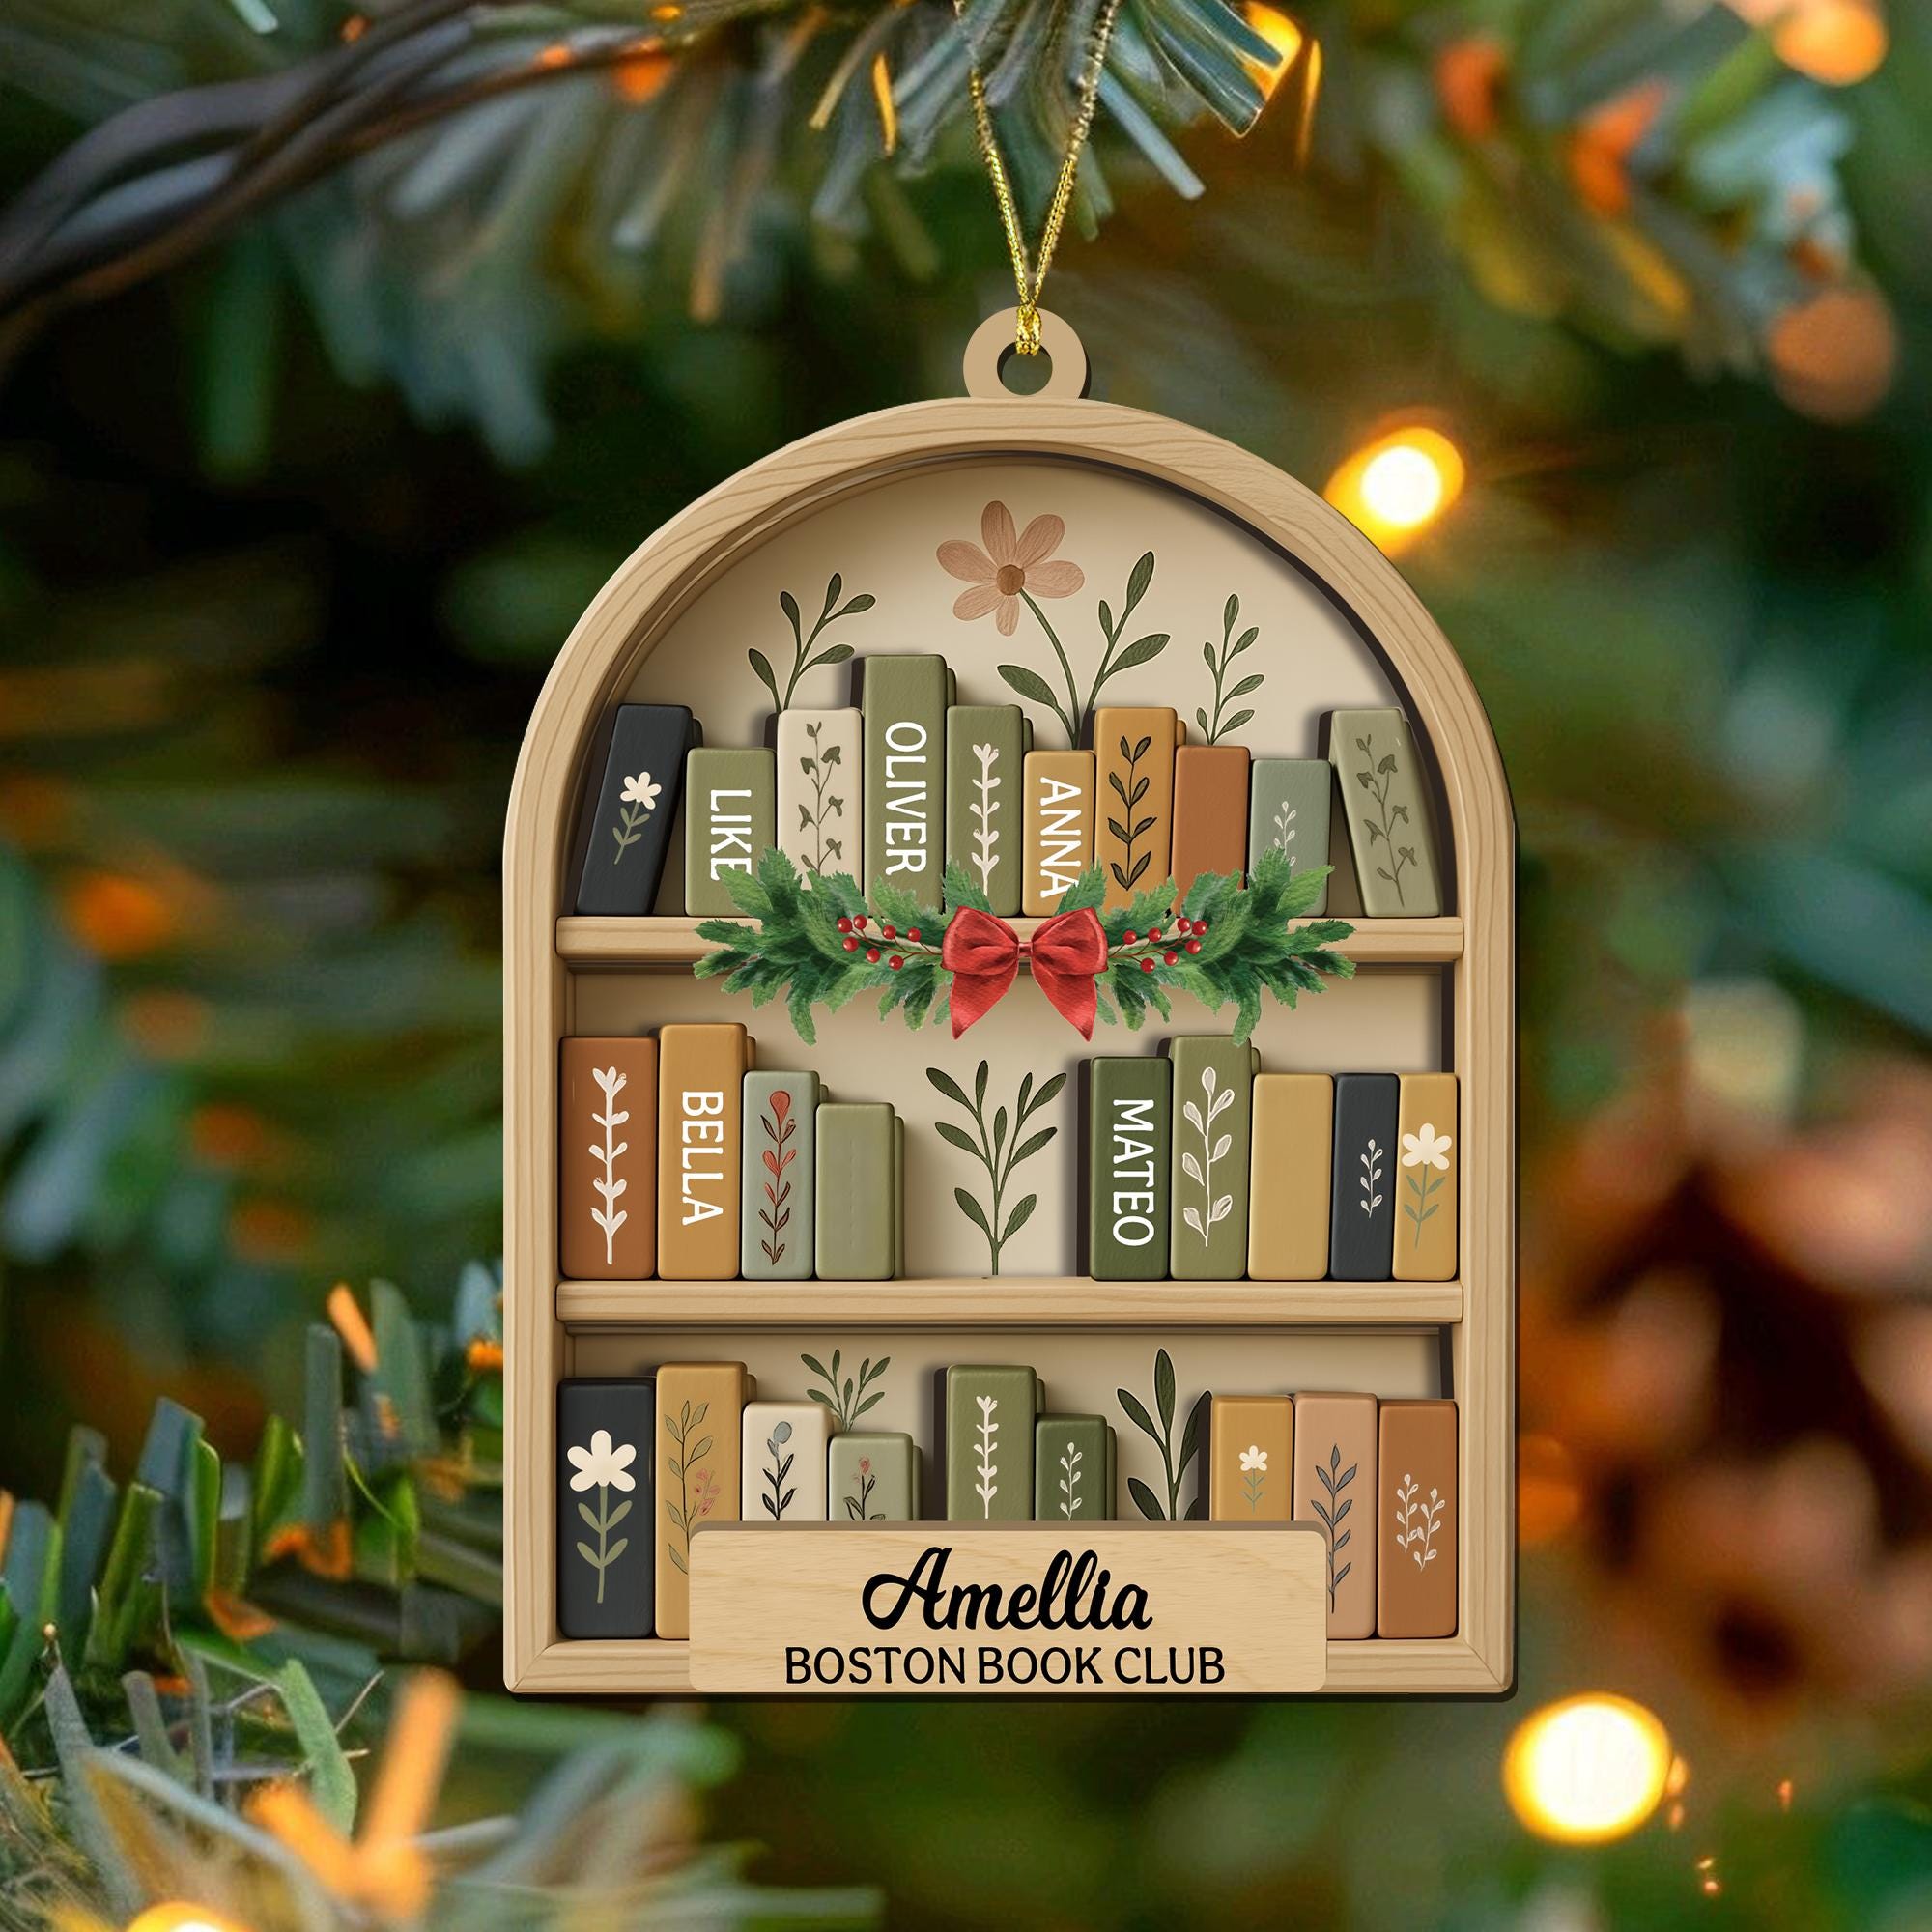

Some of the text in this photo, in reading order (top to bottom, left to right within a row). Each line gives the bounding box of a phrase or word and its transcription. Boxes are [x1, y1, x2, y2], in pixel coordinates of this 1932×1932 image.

[710, 789, 752, 881] LIKE
[885, 722, 927, 875] OLIVER
[1040, 777, 1082, 898] ANNA
[682, 1091, 724, 1226] BELLA
[1113, 1099, 1155, 1246] MATEO
[862, 1546, 1153, 1631] Amellia
[785, 1646, 1225, 1685] BOSTON BOOK CLUB
